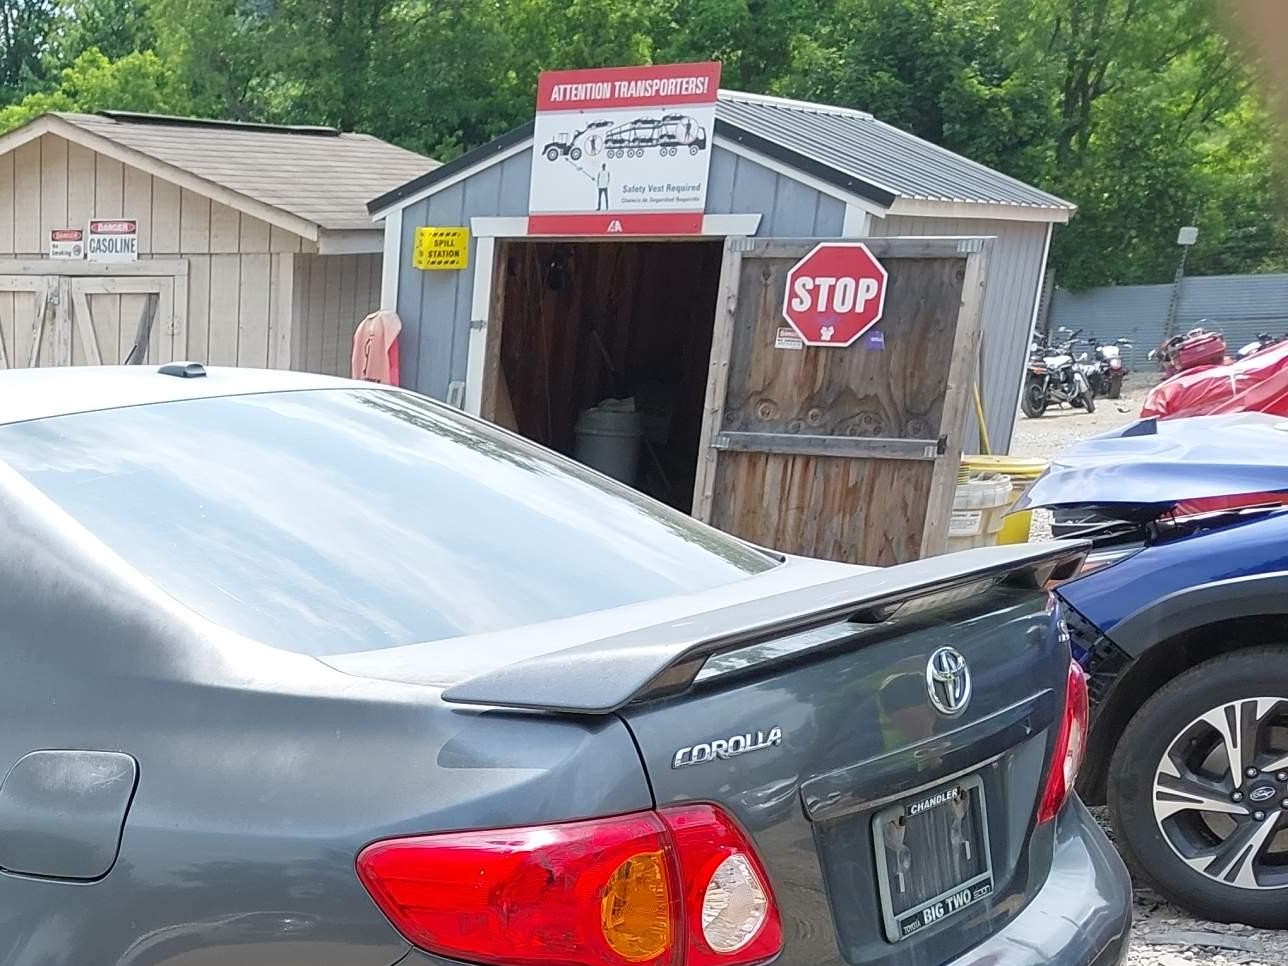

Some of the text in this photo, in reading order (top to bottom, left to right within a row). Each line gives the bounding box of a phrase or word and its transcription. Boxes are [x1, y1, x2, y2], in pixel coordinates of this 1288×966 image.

[550, 76, 709, 102] ATTENTION TRANSPORTERS!
[622, 182, 701, 194] Safety Vest Required
[89, 237, 136, 254] GASOLINE
[428, 250, 459, 258] STATION
[434, 239, 454, 247] SPILL
[791, 276, 879, 314] STOP
[673, 726, 783, 769] COROLLA
[910, 788, 959, 815] CHANDLER
[922, 902, 945, 925] BIG
[945, 889, 972, 912] TWO
